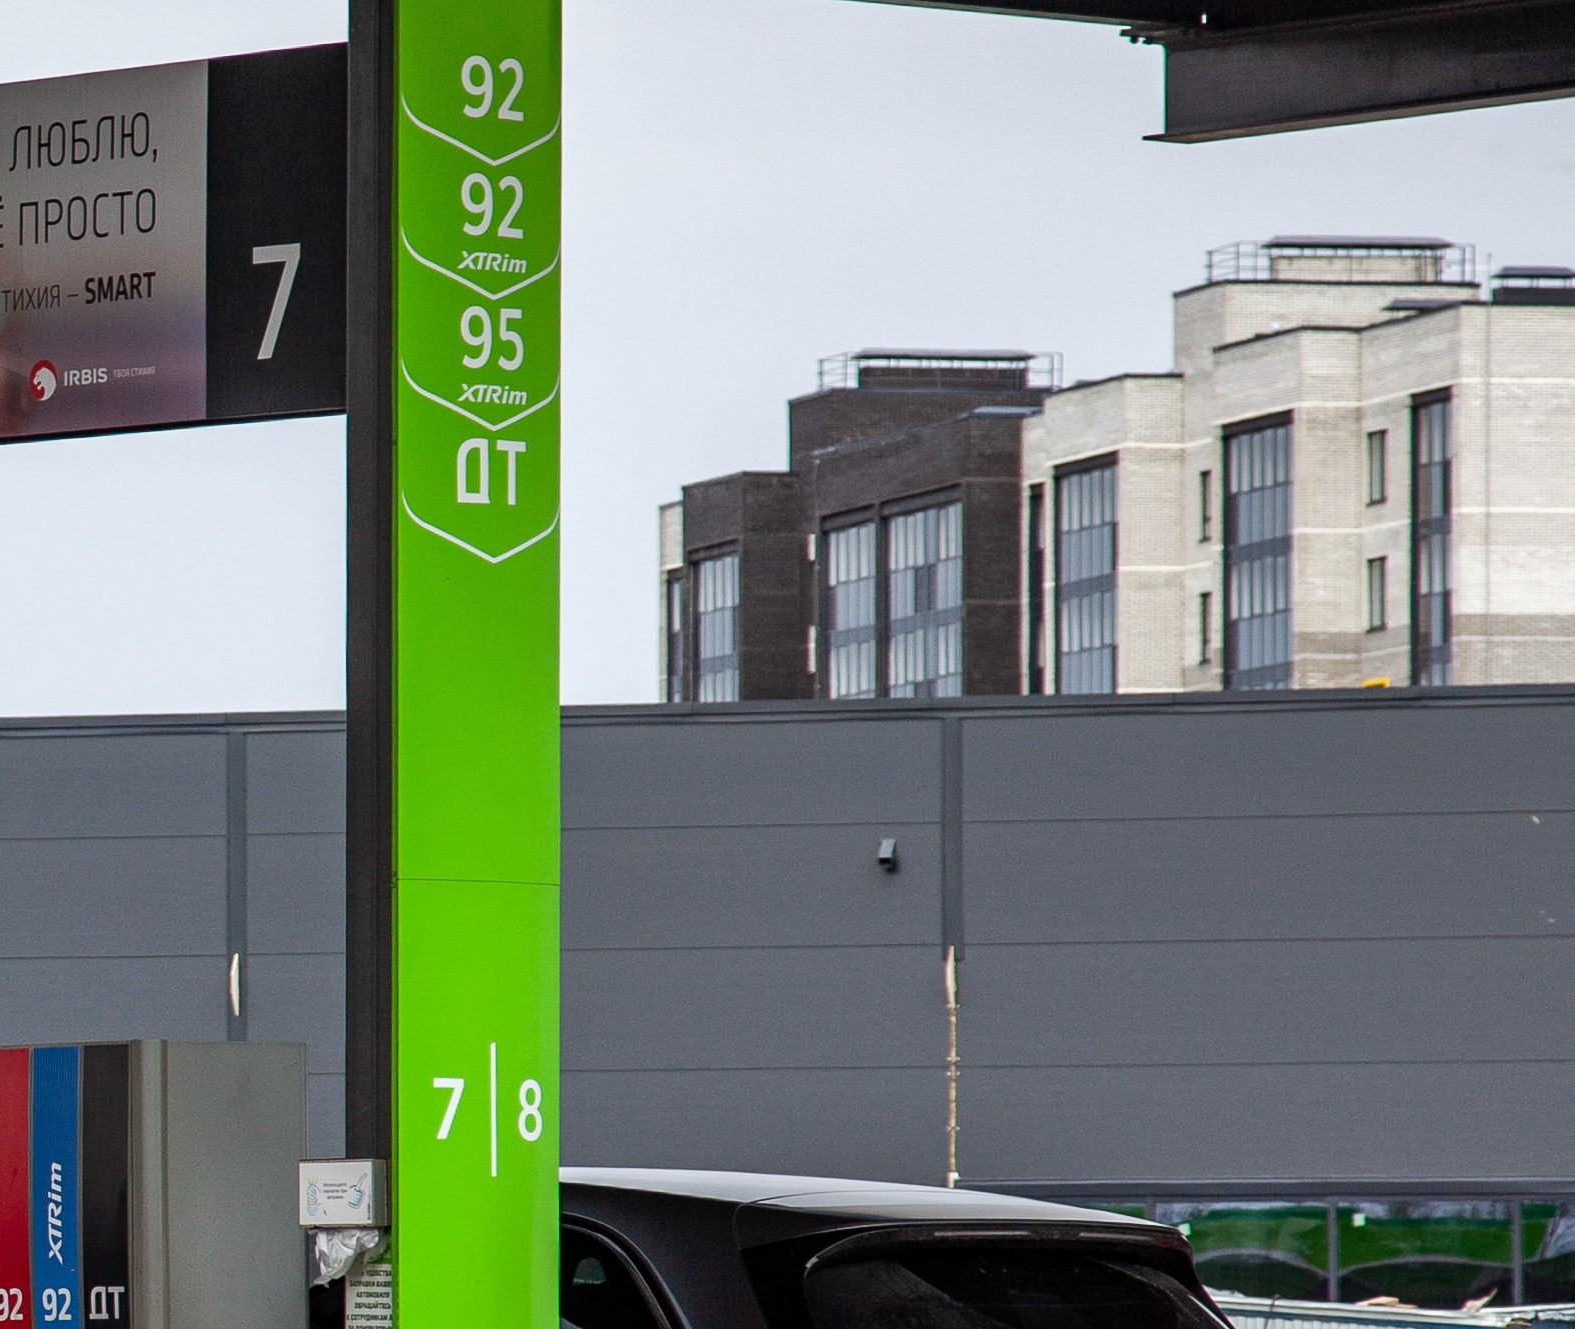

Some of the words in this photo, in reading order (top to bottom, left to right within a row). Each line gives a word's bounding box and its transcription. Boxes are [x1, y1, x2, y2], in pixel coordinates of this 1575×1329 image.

[461, 55, 525, 122] 92
[9, 112, 158, 172] ЛЮБЛЮ,
[19, 188, 157, 246] ПРОСТО
[461, 172, 525, 240] 92
[84, 271, 157, 305] SMART
[457, 250, 528, 275] XTRim
[252, 242, 302, 361] 7
[460, 305, 525, 371] 95
[63, 367, 109, 387] IRBIS
[457, 382, 528, 407] XTRim
[457, 437, 527, 506] ДТ
[432, 1077, 465, 1140] 7
[518, 1079, 543, 1142] 8
[48, 1161, 64, 1266] XTRim
[42, 1287, 72, 1322] 92
[89, 1286, 125, 1320] ДТ
